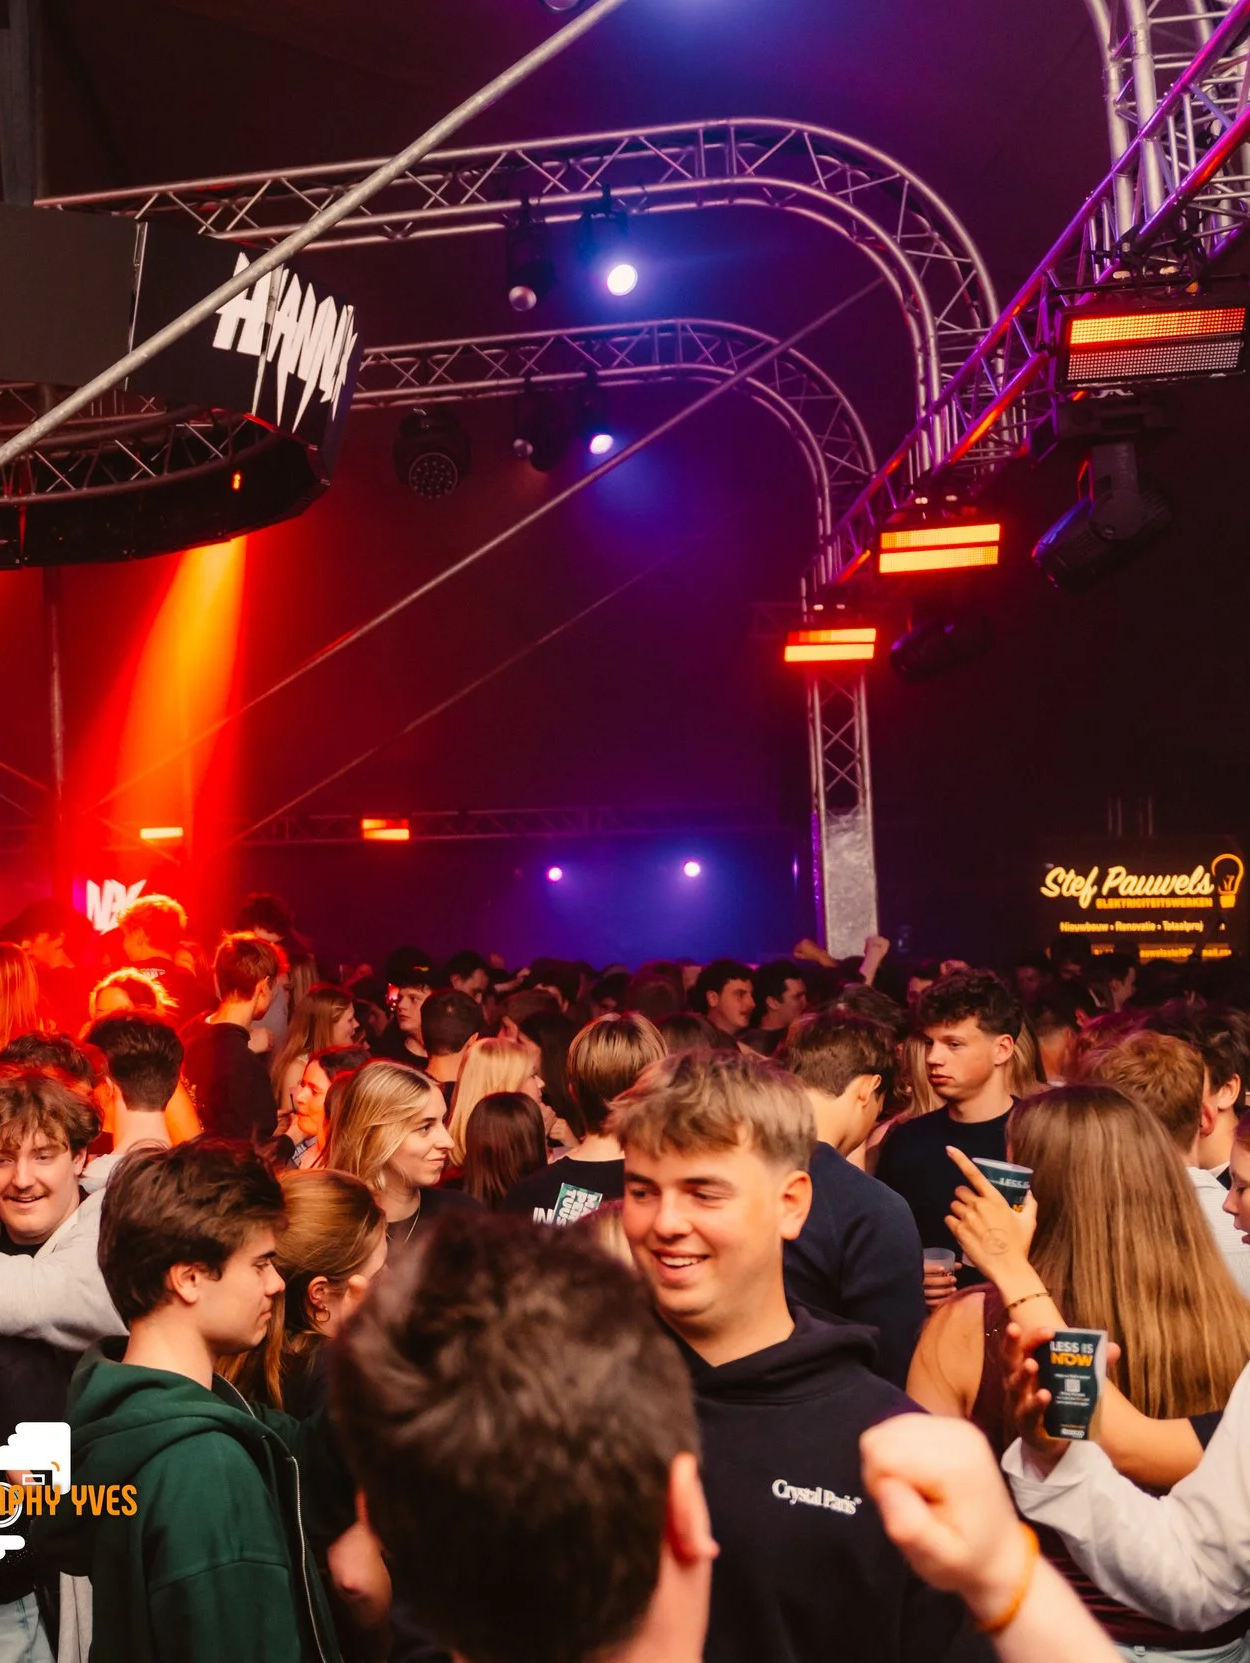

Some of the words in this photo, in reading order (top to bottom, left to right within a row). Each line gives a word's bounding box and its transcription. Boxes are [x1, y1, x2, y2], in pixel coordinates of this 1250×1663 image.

[1040, 865, 1099, 909] Stef
[1101, 864, 1215, 896] Pauwels
[1050, 1341, 1079, 1353] LESS
[1050, 1352, 1094, 1368] NOW
[771, 1478, 823, 1506] Crystal
